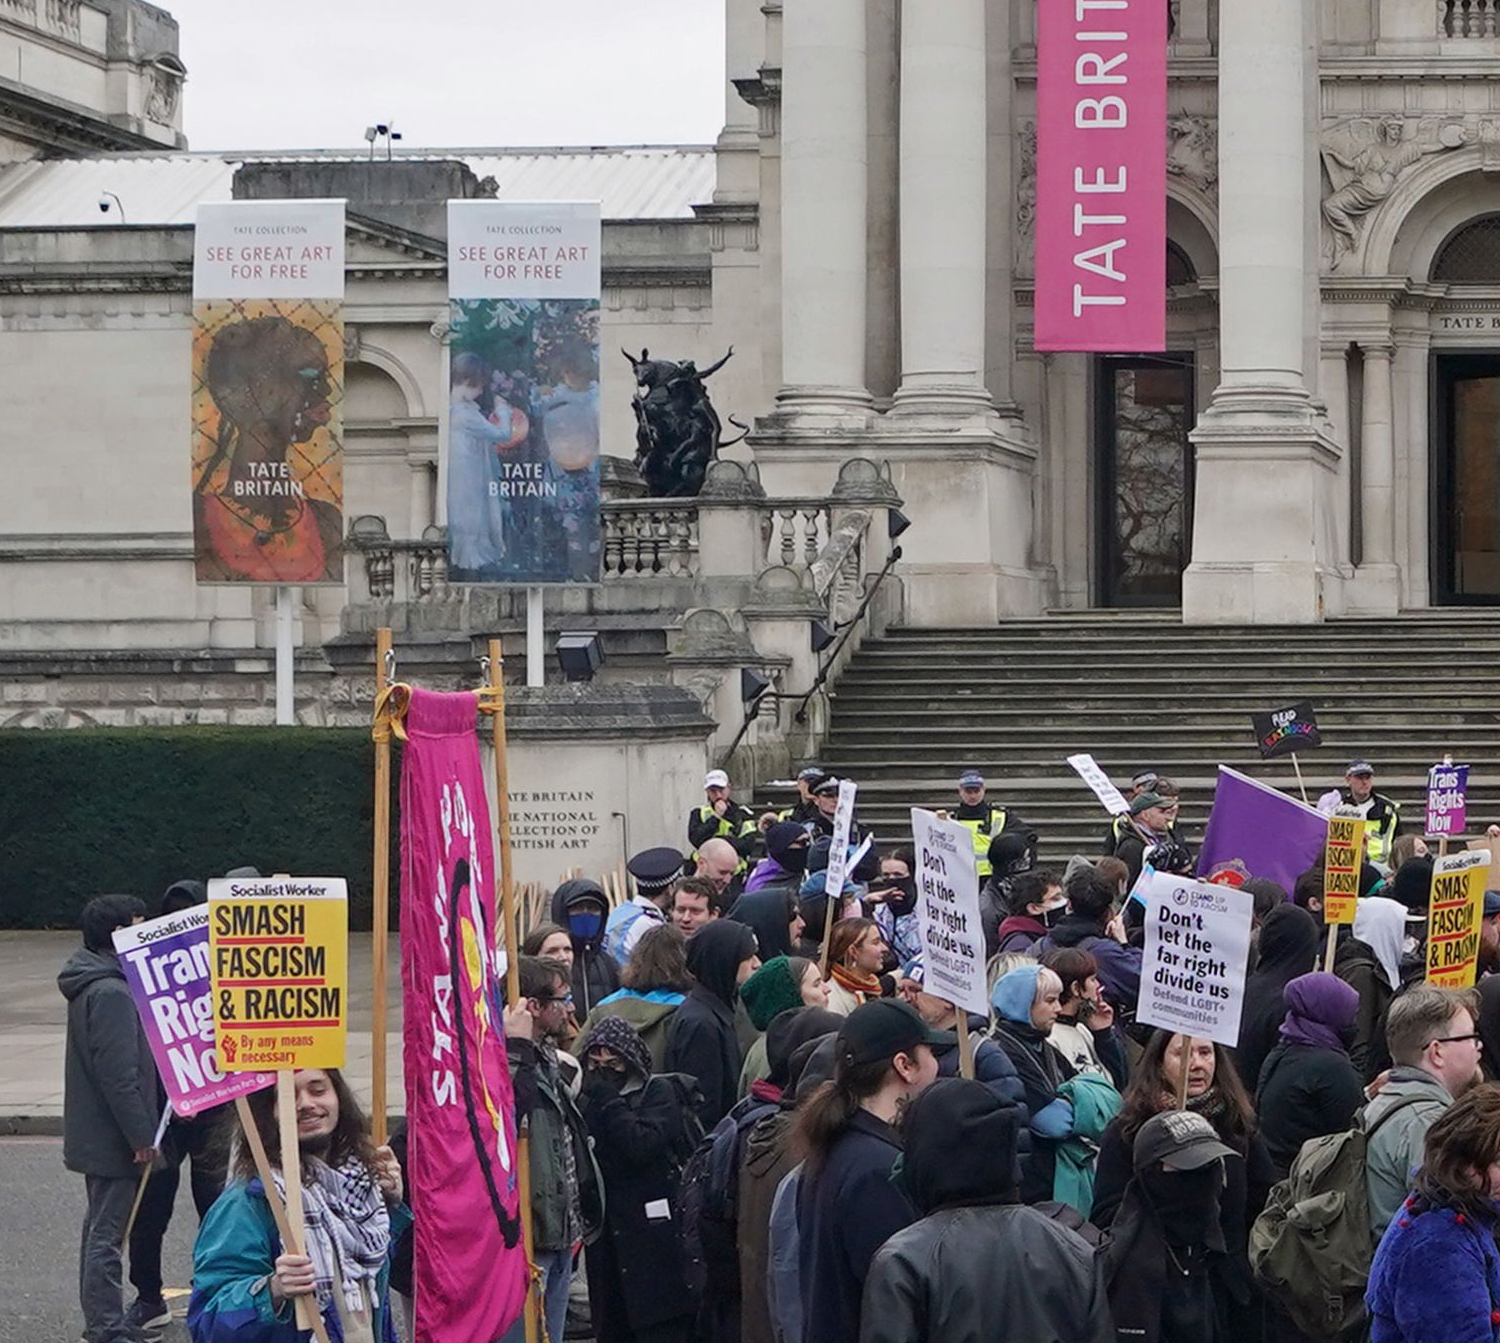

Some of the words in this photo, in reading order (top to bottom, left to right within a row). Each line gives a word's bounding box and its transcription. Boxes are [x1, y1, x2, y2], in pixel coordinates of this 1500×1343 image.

[234, 226, 252, 234] TATE
[256, 226, 307, 234] COLLECTION
[486, 226, 505, 234] TATE
[509, 226, 562, 234] COLLECTION
[1073, 163, 1127, 319] TATE
[206, 247, 233, 261] SEE
[241, 247, 293, 261] GREAT
[301, 247, 332, 261] ART
[459, 247, 487, 261] SEE
[494, 247, 546, 261] GREAT
[554, 247, 588, 261] ART
[231, 265, 262, 279] FOR
[269, 265, 308, 279] FREE
[484, 265, 515, 279] FOR
[523, 265, 562, 279] FREE
[1439, 316, 1486, 330] TATE
[248, 463, 289, 478] TATE
[502, 463, 544, 478] TATE
[233, 481, 304, 497] BRITAIN
[488, 481, 557, 497] BRITAIN
[1271, 709, 1297, 727] READ
[1429, 768, 1458, 789] Trans
[532, 792, 594, 801] BRITAIN
[1428, 791, 1464, 814] Rights
[524, 812, 597, 821] NATIONAL
[1428, 811, 1452, 832] Now
[581, 825, 600, 834] OF
[510, 839, 555, 849] RITISH
[560, 839, 590, 849] ART
[231, 885, 285, 897] Socialist
[286, 884, 327, 896] Worker
[922, 873, 935, 897] let
[937, 881, 955, 903] the
[216, 905, 305, 936] SMASH
[941, 908, 967, 933] right
[1159, 905, 1203, 931] Don't
[137, 918, 189, 944] Socialist
[1158, 926, 1180, 945] let
[1185, 933, 1212, 953] the
[926, 926, 957, 953] divide
[959, 942, 974, 959] us
[217, 946, 325, 977] FASCISM
[1157, 946, 1179, 966] far
[1184, 955, 1227, 978] right
[1430, 944, 1439, 968] &
[126, 940, 211, 996] Tran
[1154, 967, 1205, 993] divide
[1209, 986, 1230, 999] us
[219, 990, 236, 1020] &
[245, 988, 340, 1019] RACISM
[1153, 987, 1189, 1005] Defend
[1191, 997, 1225, 1012] LGBT+
[150, 990, 214, 1045] Rig
[1152, 1001, 1218, 1025] communities
[241, 1035, 254, 1050] By
[257, 1036, 276, 1050] any
[281, 1036, 314, 1047] means
[241, 1049, 296, 1064] necessary
[167, 1043, 227, 1094] No
